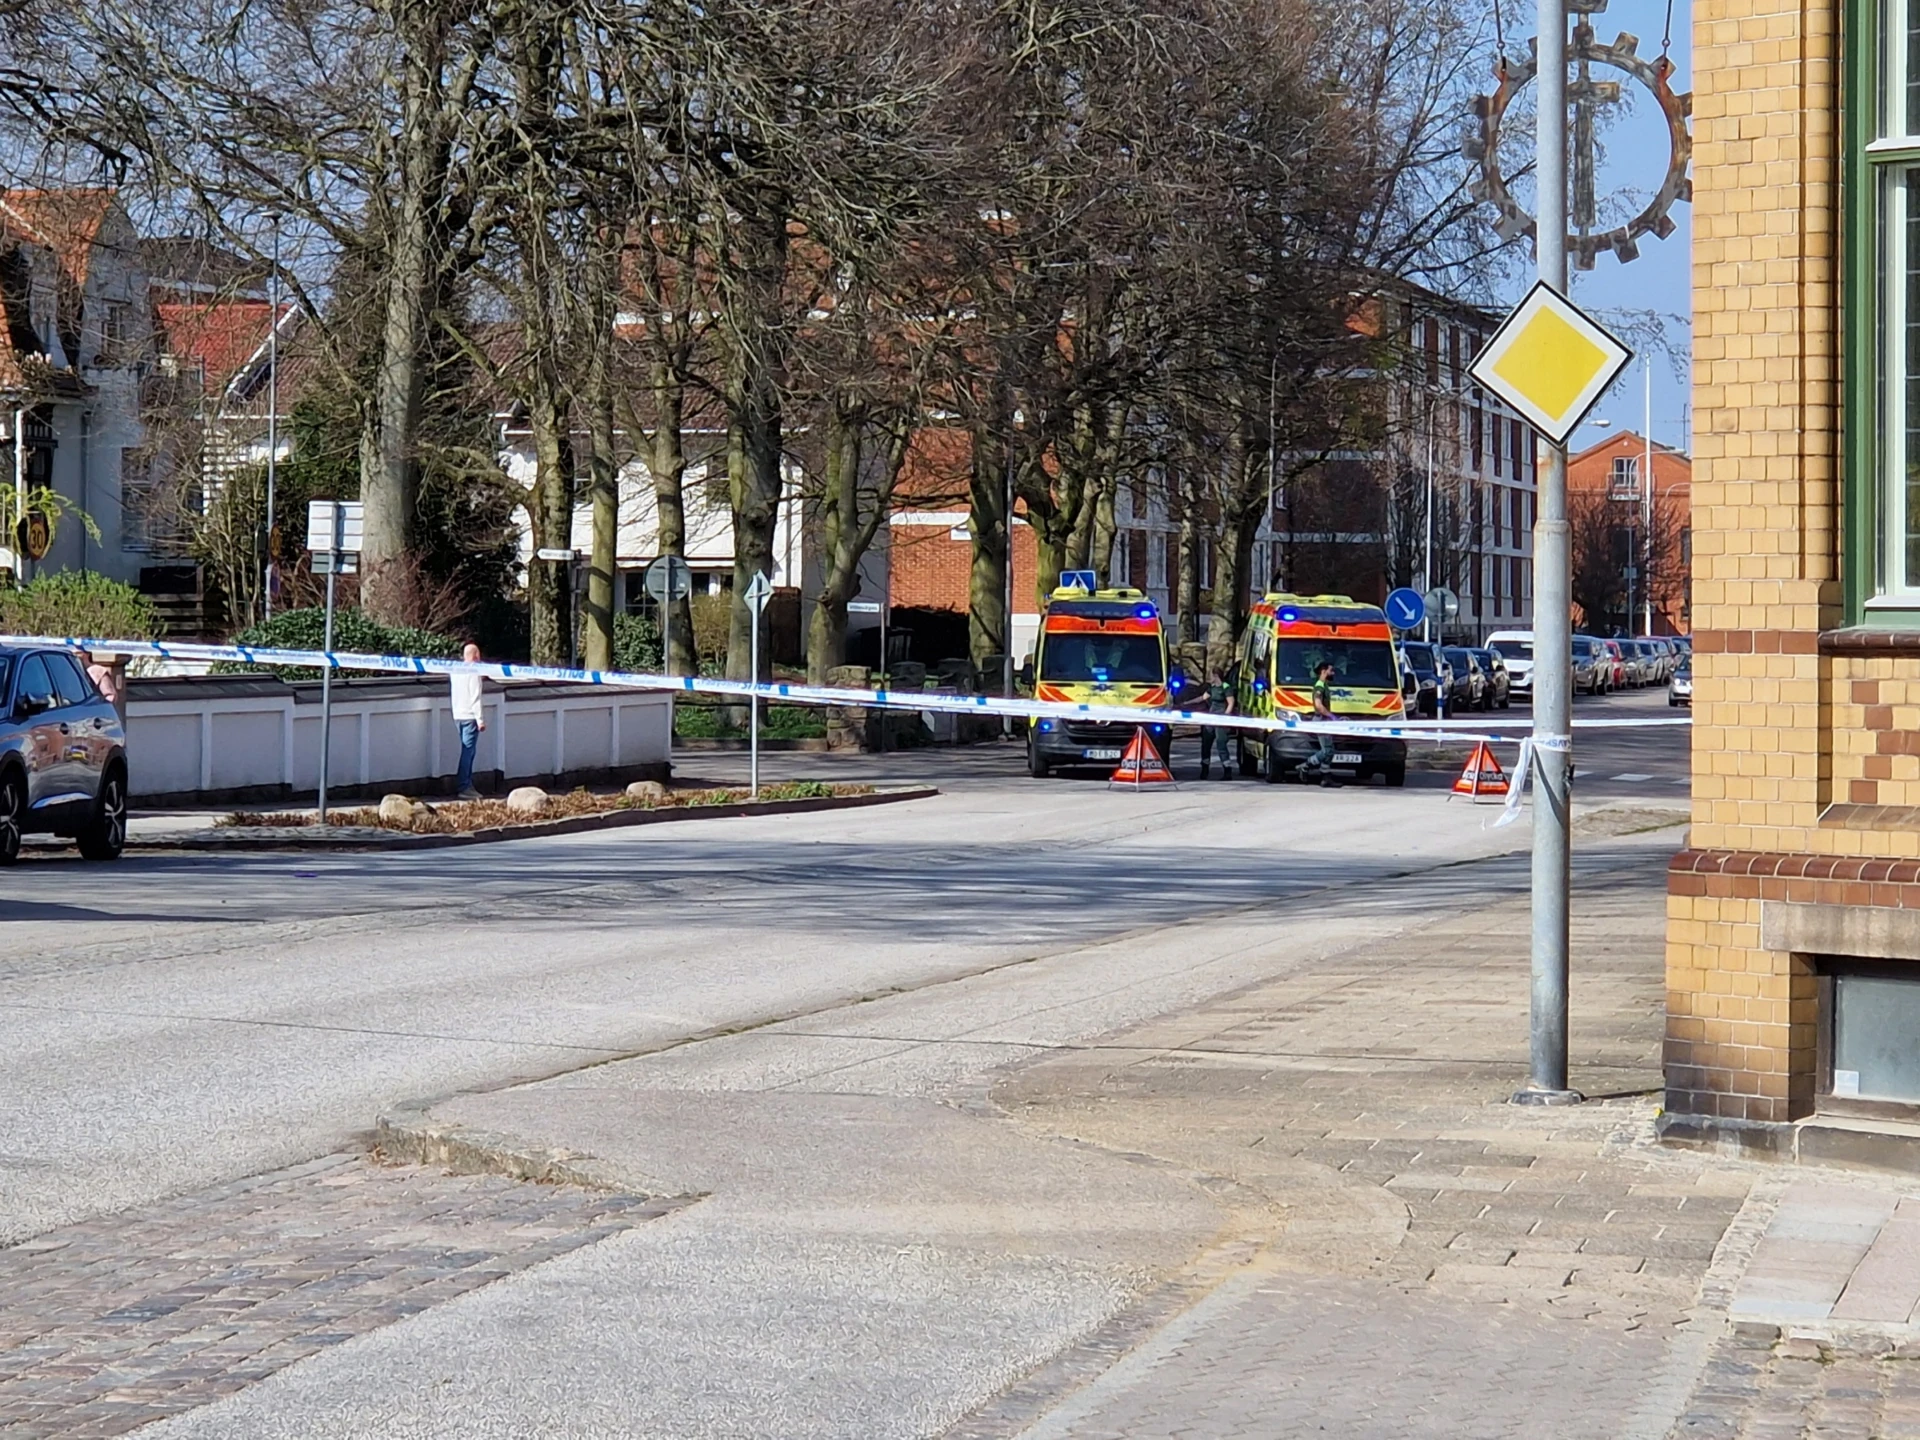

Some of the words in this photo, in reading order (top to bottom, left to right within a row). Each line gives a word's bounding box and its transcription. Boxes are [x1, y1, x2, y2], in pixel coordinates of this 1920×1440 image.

[31, 530, 43, 549] 30
[381, 657, 408, 668] POLIS
[556, 669, 585, 679] POLIS
